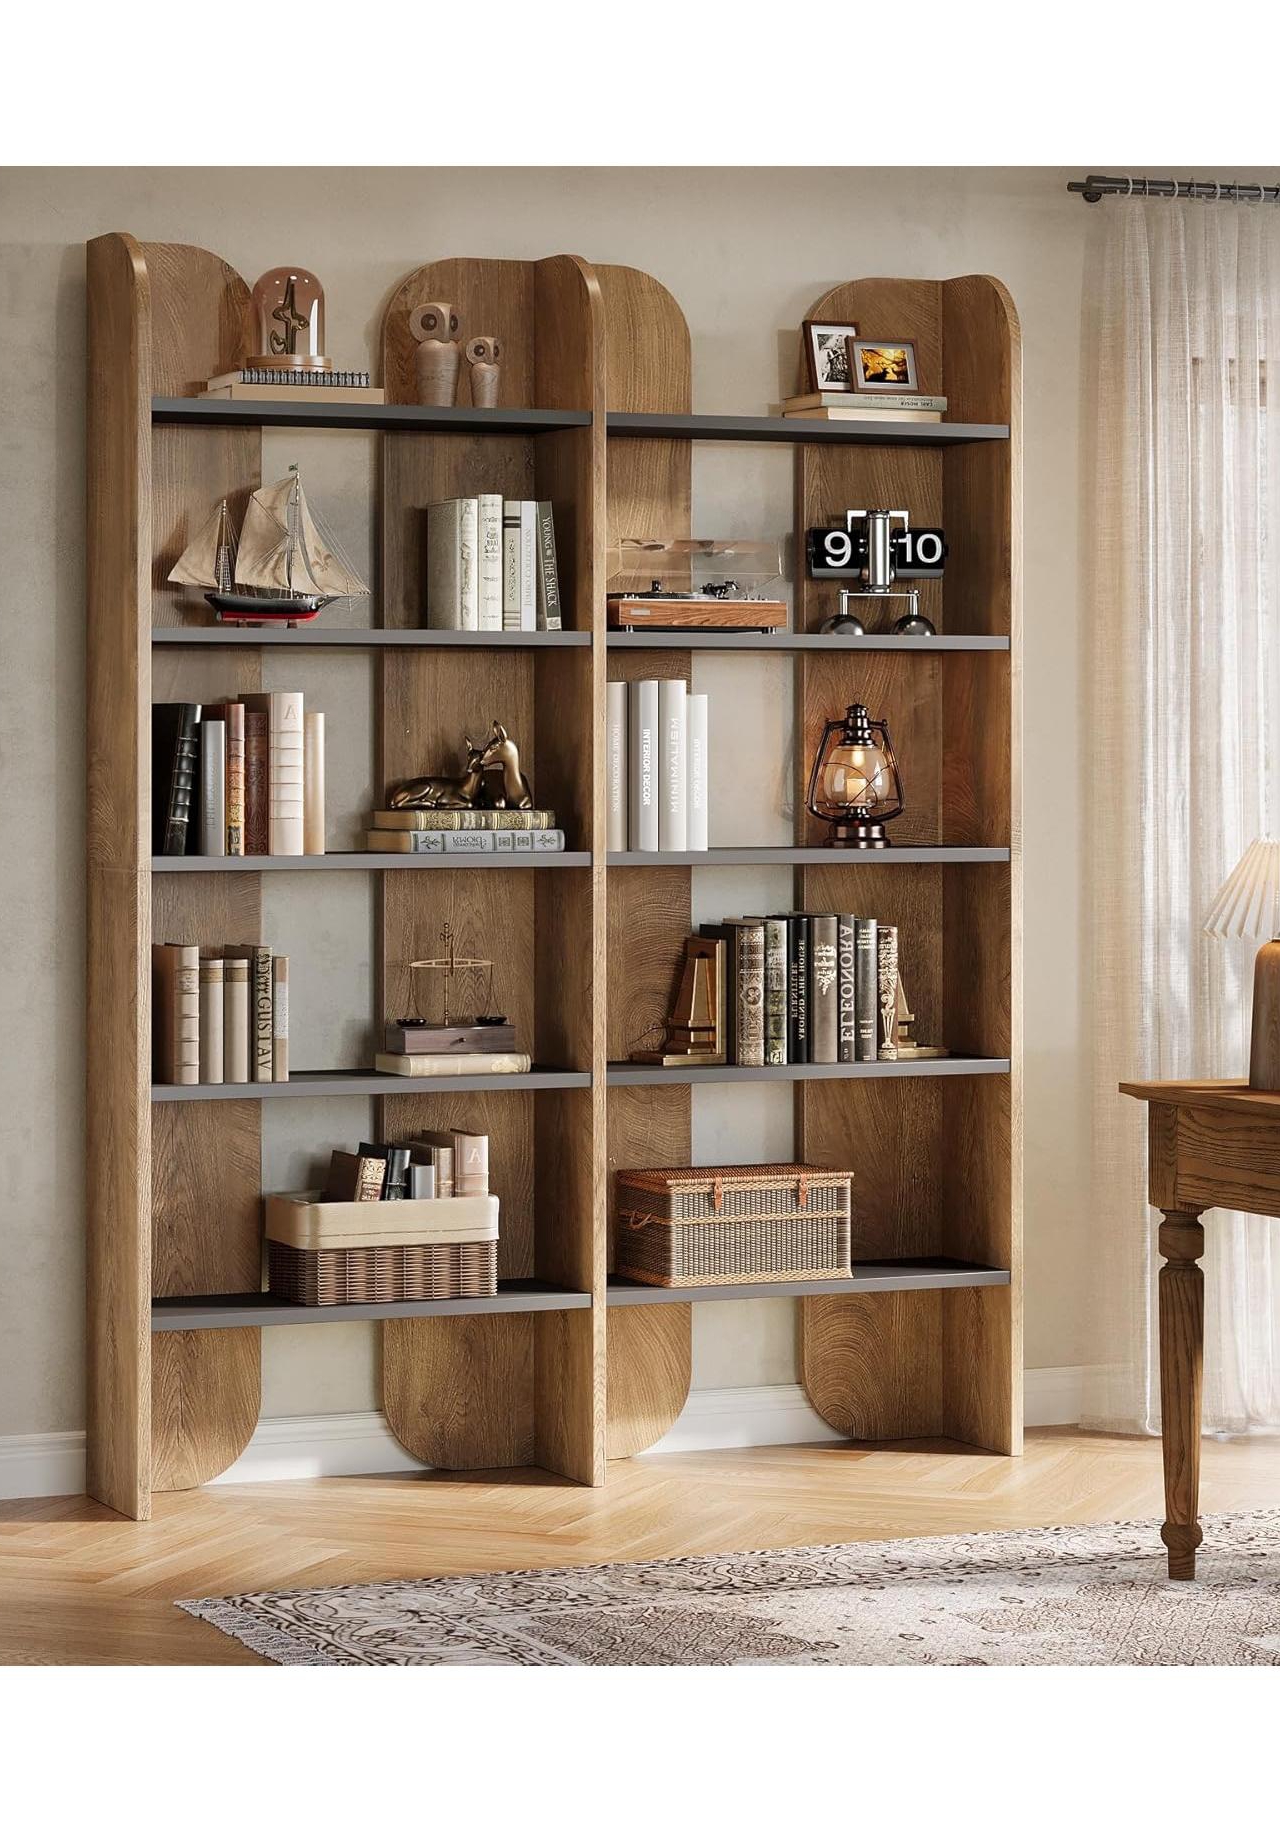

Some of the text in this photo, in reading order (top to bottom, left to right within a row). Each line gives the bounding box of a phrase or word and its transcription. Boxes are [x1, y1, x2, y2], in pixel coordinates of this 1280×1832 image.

[543, 517, 558, 607] YOUNG THE SHACK
[824, 531, 851, 567] 9
[902, 531, 942, 565] 10
[284, 704, 298, 720] A
[643, 729, 651, 806] INTERIOR DECOR
[670, 717, 680, 814] MINIMALISM
[258, 996, 271, 1070] GUSTAV
[466, 1148, 482, 1164] A
